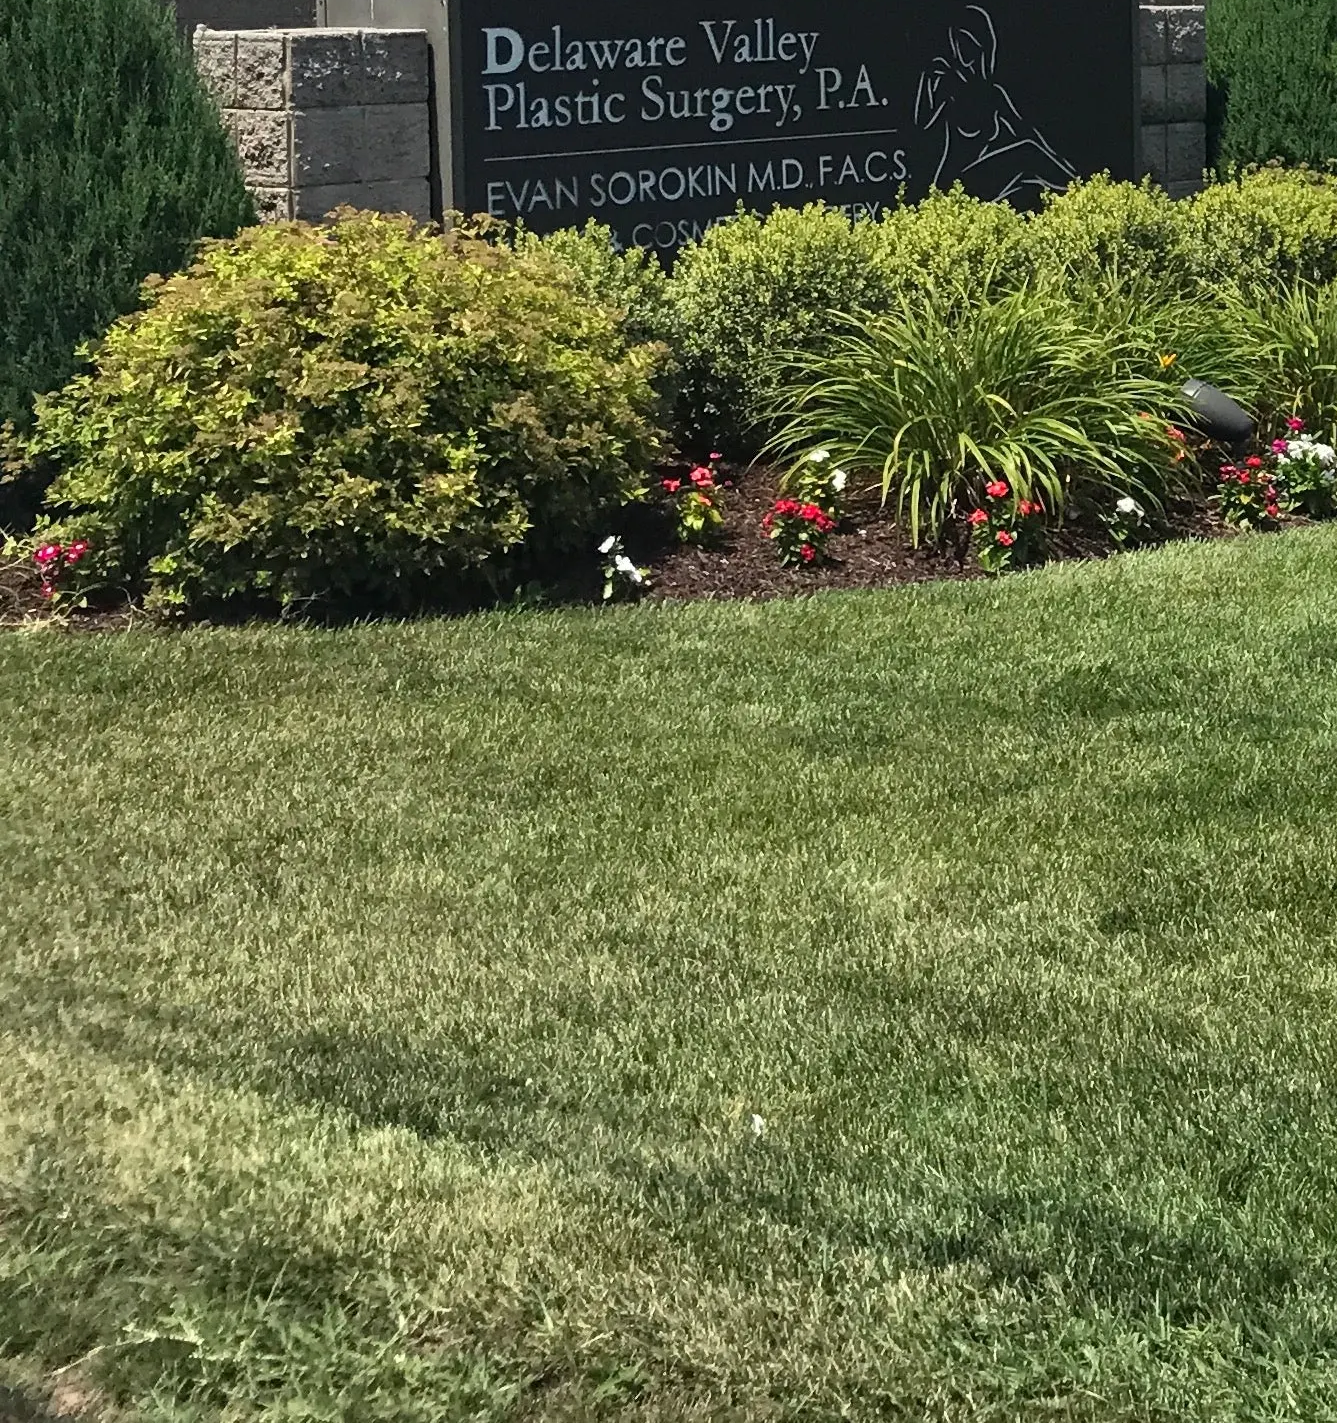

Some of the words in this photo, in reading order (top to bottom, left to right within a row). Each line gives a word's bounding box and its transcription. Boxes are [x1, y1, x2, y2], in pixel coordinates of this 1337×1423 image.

[481, 24, 687, 75] Delaware
[699, 17, 821, 75] Valley
[482, 78, 627, 131] Plastic
[641, 75, 802, 133] Surgery,
[814, 64, 889, 110] P.A.
[487, 176, 579, 217] EVAN
[590, 163, 737, 207] SOROKIN
[819, 149, 912, 187] F.A.C.S.
